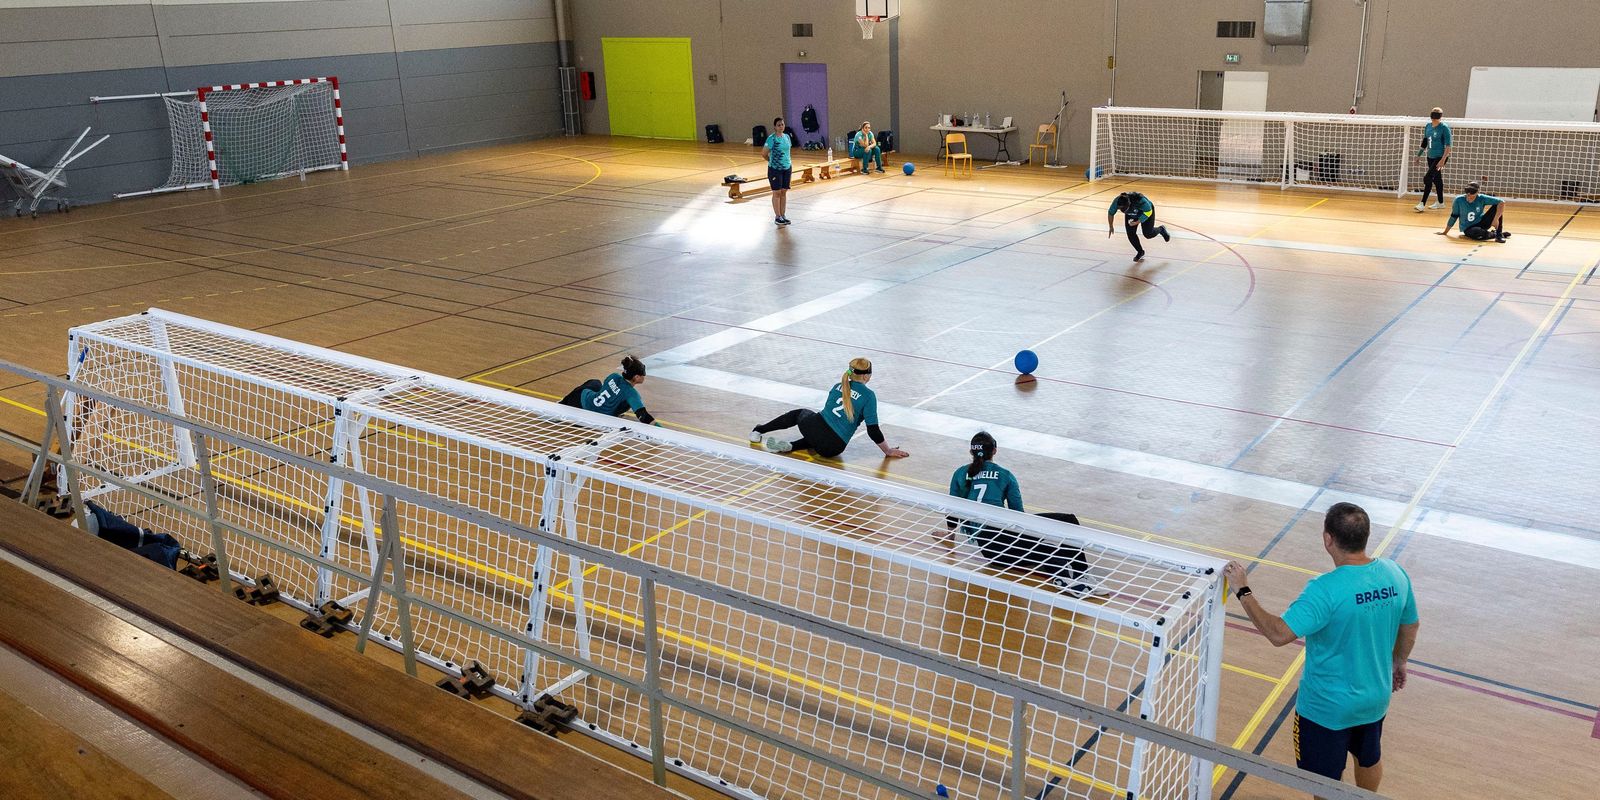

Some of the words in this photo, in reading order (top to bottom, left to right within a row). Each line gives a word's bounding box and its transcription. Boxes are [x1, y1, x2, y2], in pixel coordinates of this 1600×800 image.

[1467, 211, 1476, 222] 6
[593, 390, 611, 407] 5
[832, 397, 844, 418] 2
[973, 483, 988, 503] 7
[1355, 586, 1398, 605] BRASIL
